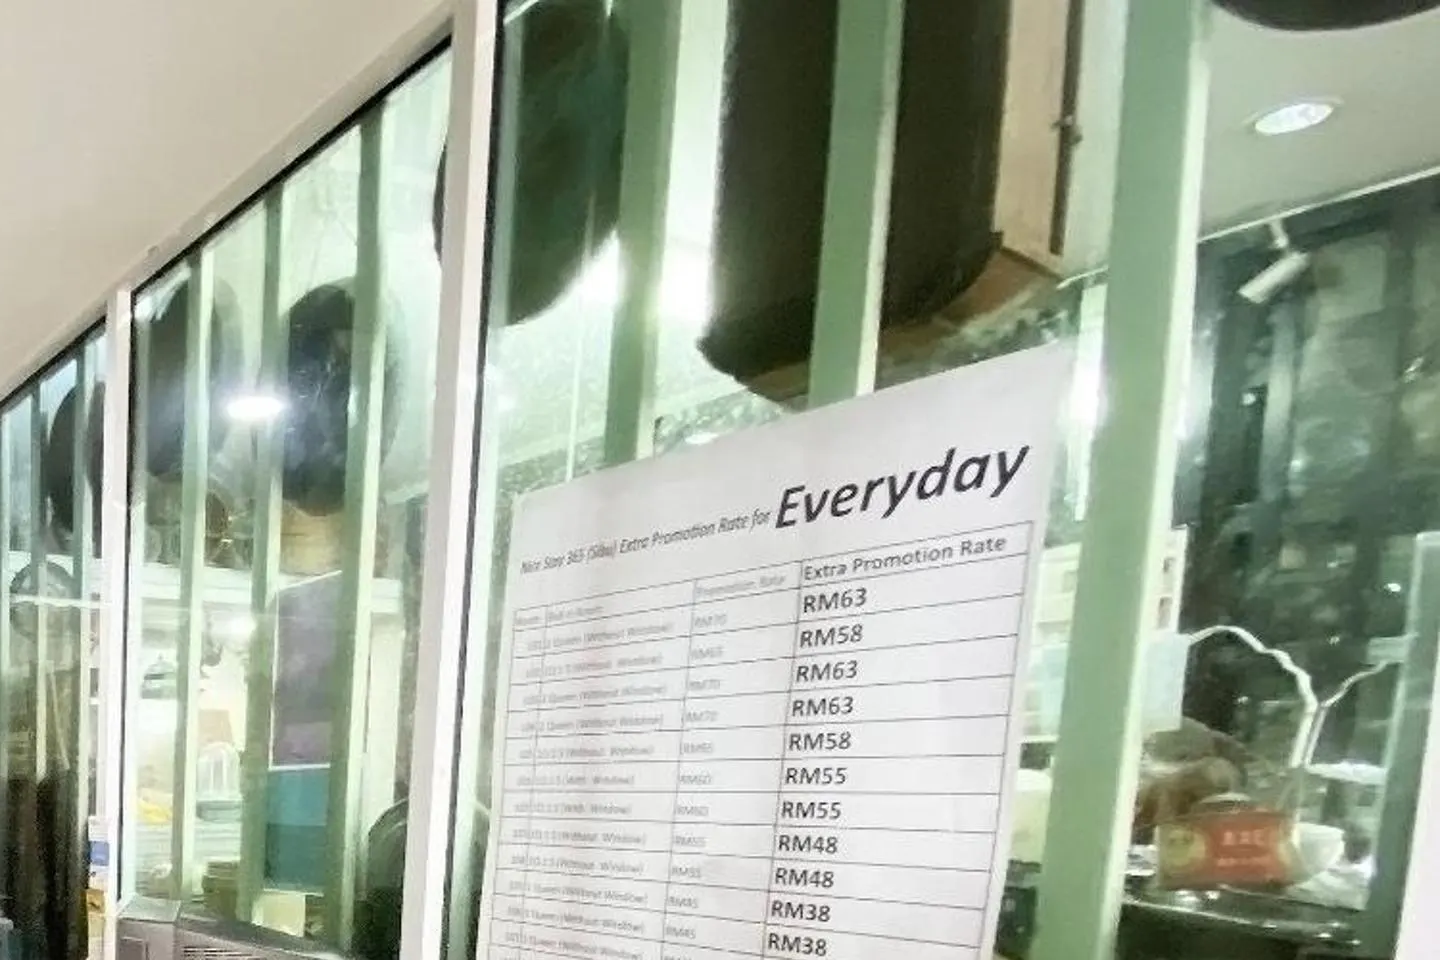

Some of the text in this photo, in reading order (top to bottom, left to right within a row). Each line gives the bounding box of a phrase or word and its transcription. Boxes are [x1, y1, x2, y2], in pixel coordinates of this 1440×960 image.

[619, 537, 650, 554] Extra
[651, 522, 716, 547] Promotion
[717, 515, 749, 534] Rate
[749, 508, 771, 531] for
[774, 445, 1031, 529] Everyday
[804, 536, 1007, 582] Extra Promotion Rate
[803, 588, 867, 613] RM63
[800, 624, 863, 648] RM58
[796, 660, 858, 682] RM63
[792, 696, 854, 717] RM63
[788, 731, 851, 750] RM58
[785, 767, 847, 785] RM55
[781, 801, 842, 819] RM55
[778, 834, 838, 854] RM48
[774, 867, 835, 888] RM48
[771, 900, 831, 922] RM38
[768, 932, 827, 956] RM38
